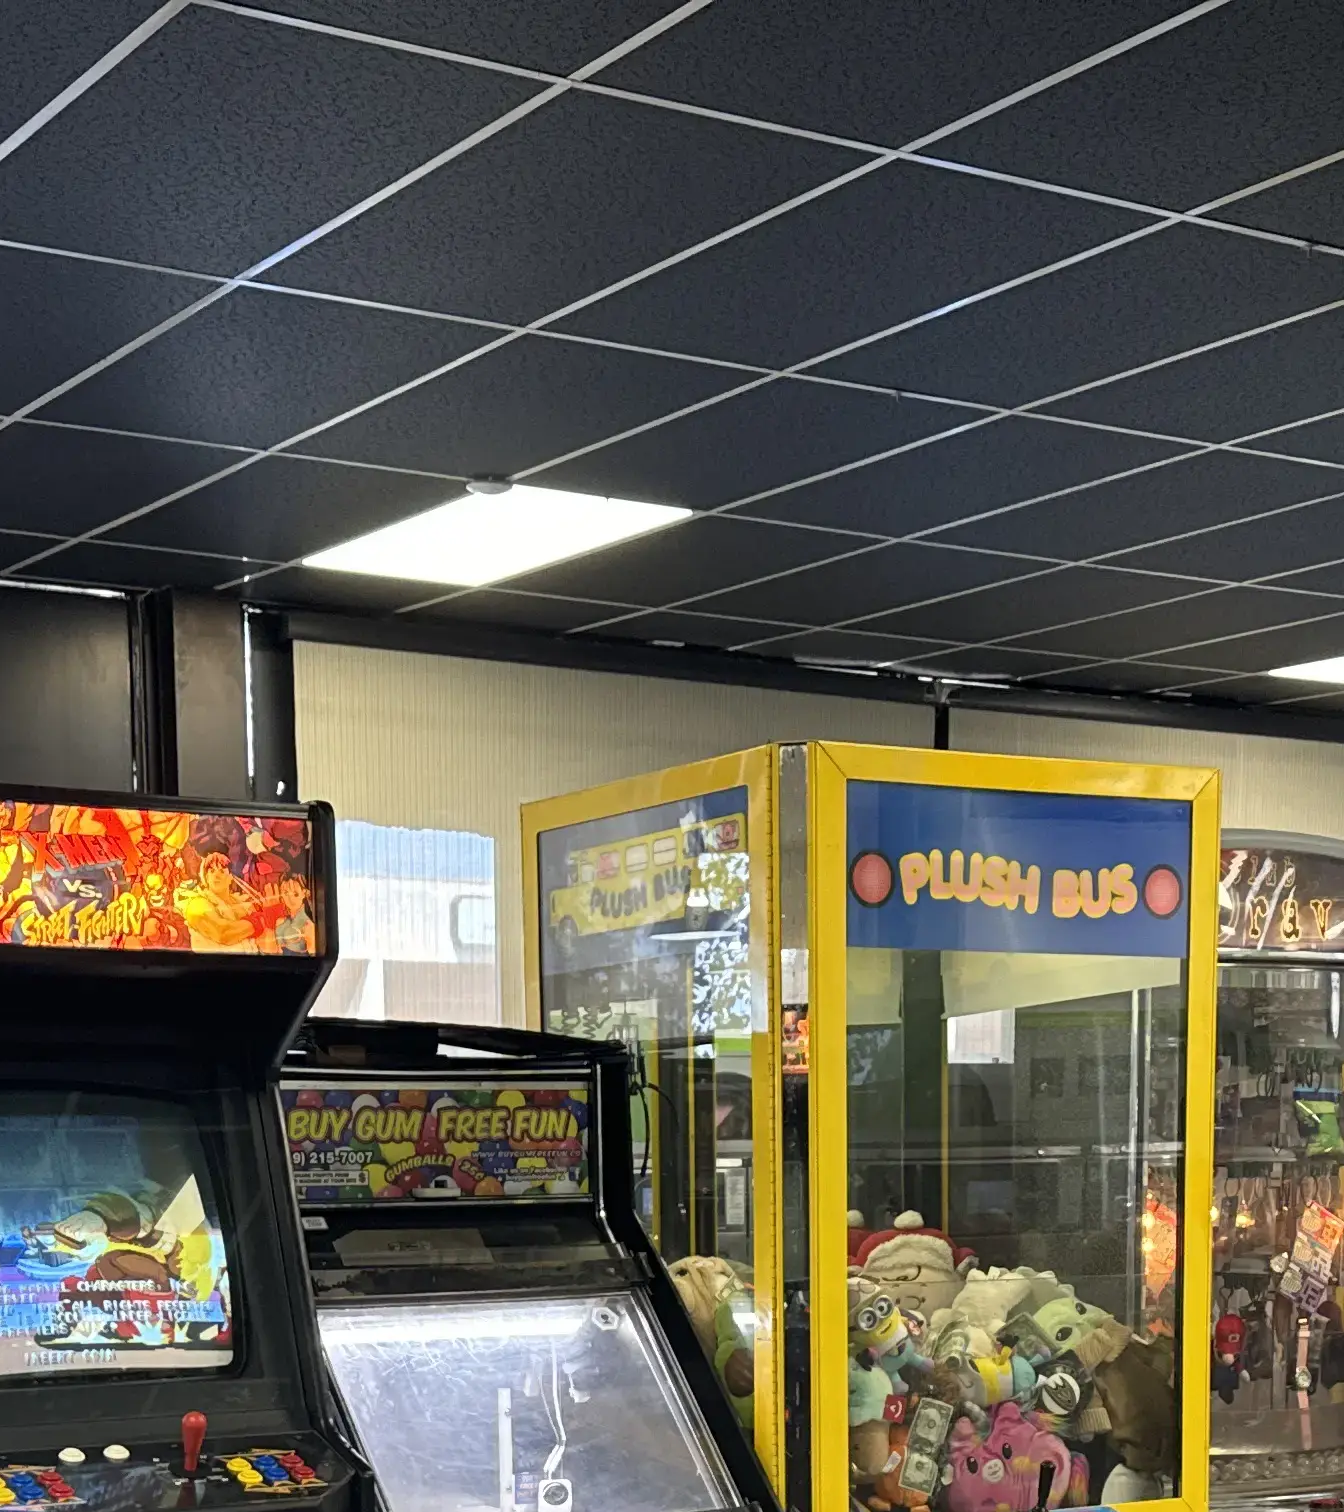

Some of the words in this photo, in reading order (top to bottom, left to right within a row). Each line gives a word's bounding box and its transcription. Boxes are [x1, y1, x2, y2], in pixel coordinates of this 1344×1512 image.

[19, 829, 140, 876] X-MEN
[62, 878, 103, 899] VS.
[898, 848, 1042, 915] PLUSH
[1051, 862, 1139, 919] BUS
[21, 900, 78, 945] STREET
[75, 891, 150, 946] FIGHTER
[287, 1107, 352, 1143] BUY
[354, 1107, 425, 1143] GUM
[438, 1107, 511, 1142] FREE
[513, 1106, 570, 1142] FUN
[309, 1151, 373, 1165] 215-7007
[384, 1152, 455, 1184] GUMBALLS
